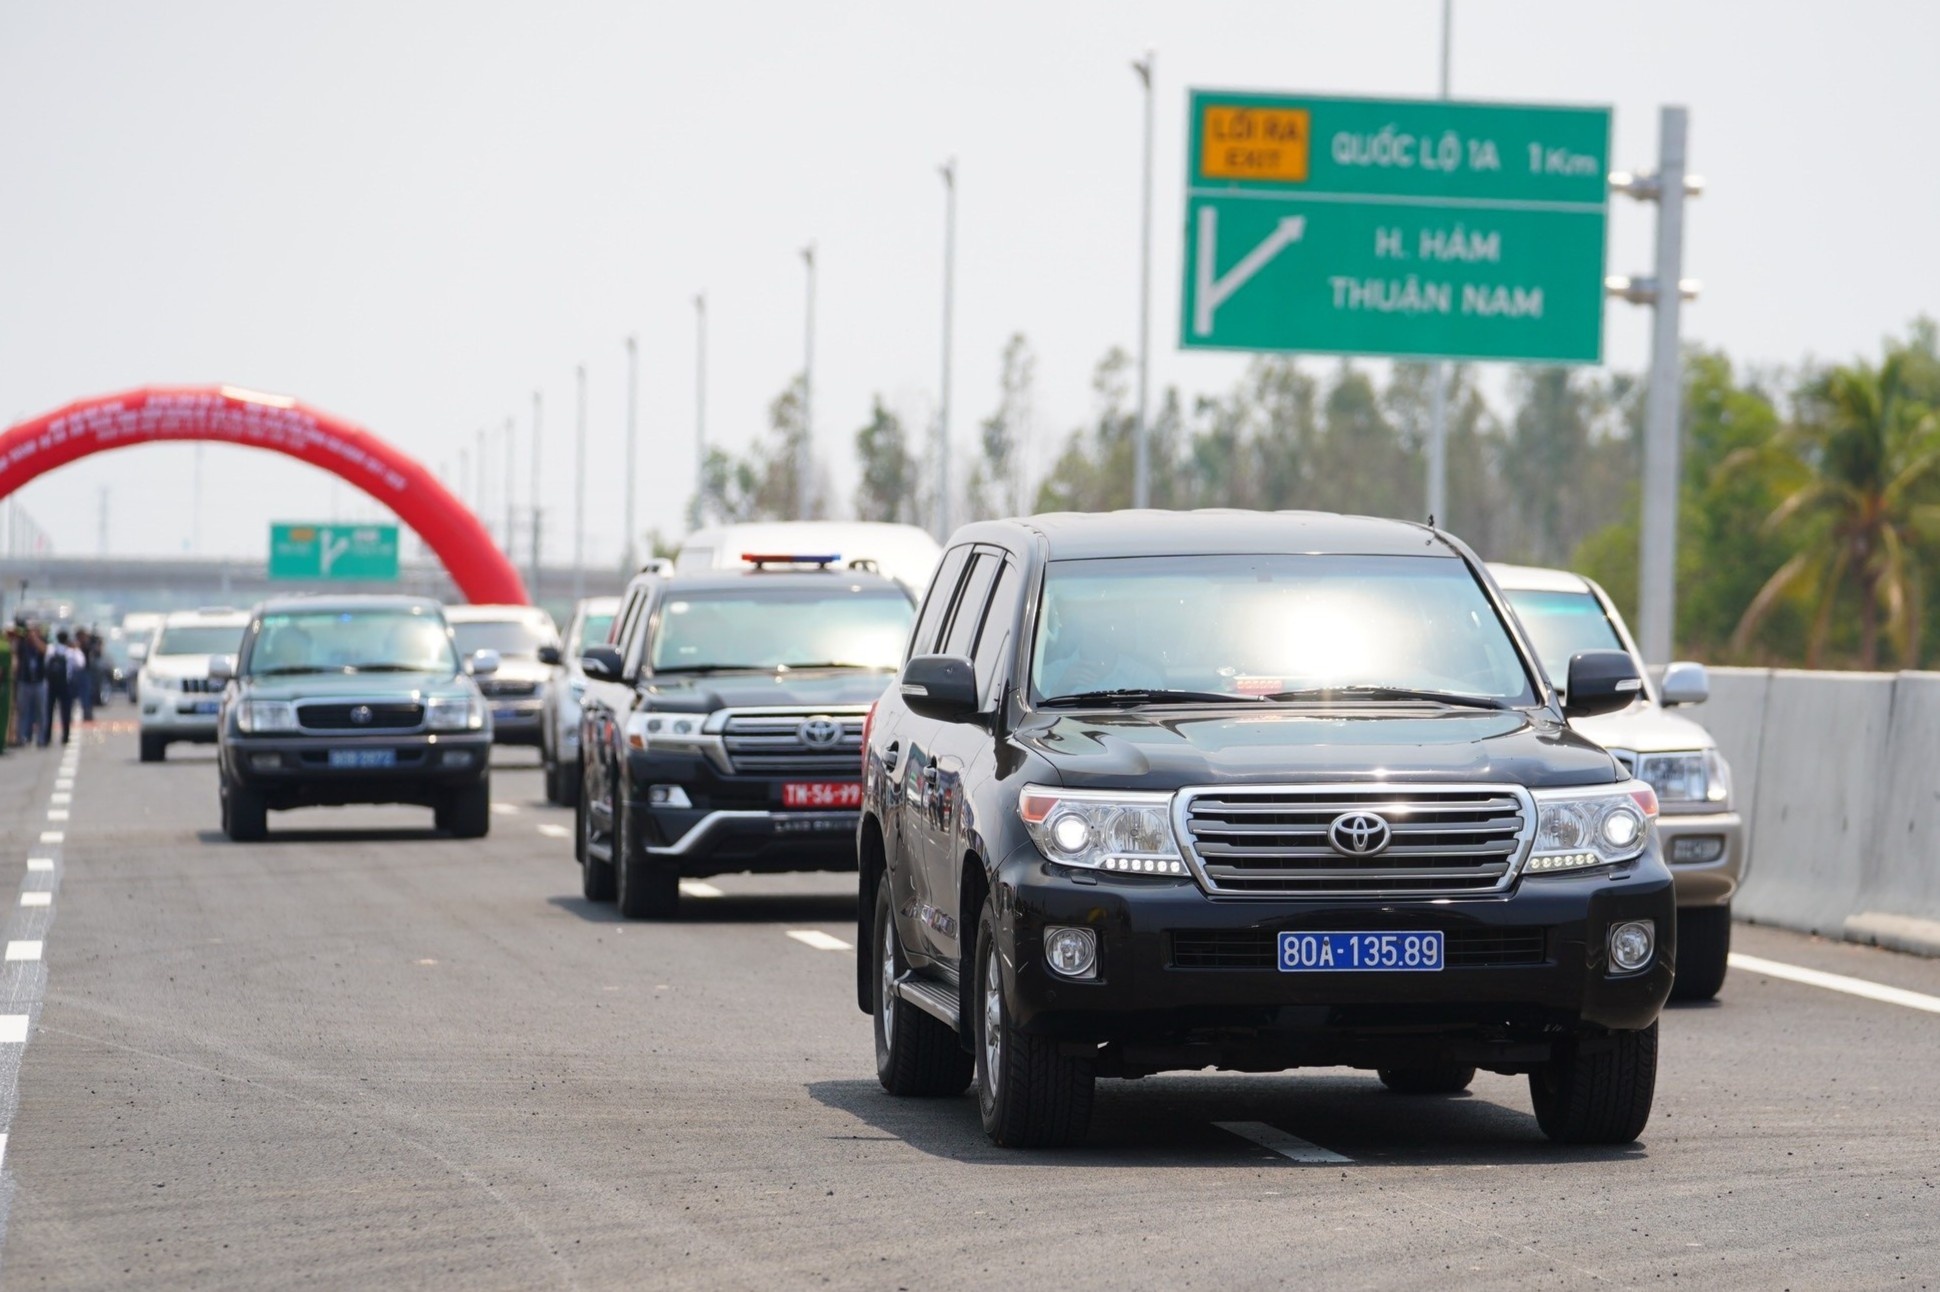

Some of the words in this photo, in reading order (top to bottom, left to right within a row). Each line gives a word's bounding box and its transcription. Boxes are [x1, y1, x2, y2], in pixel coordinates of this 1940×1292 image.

[1331, 123, 1415, 168] QUỐC
[1419, 130, 1461, 173] LỘ
[1467, 138, 1500, 171] 1A
[1461, 283, 1545, 319] NAM
[1283, 935, 1438, 967] 80A-135.89
